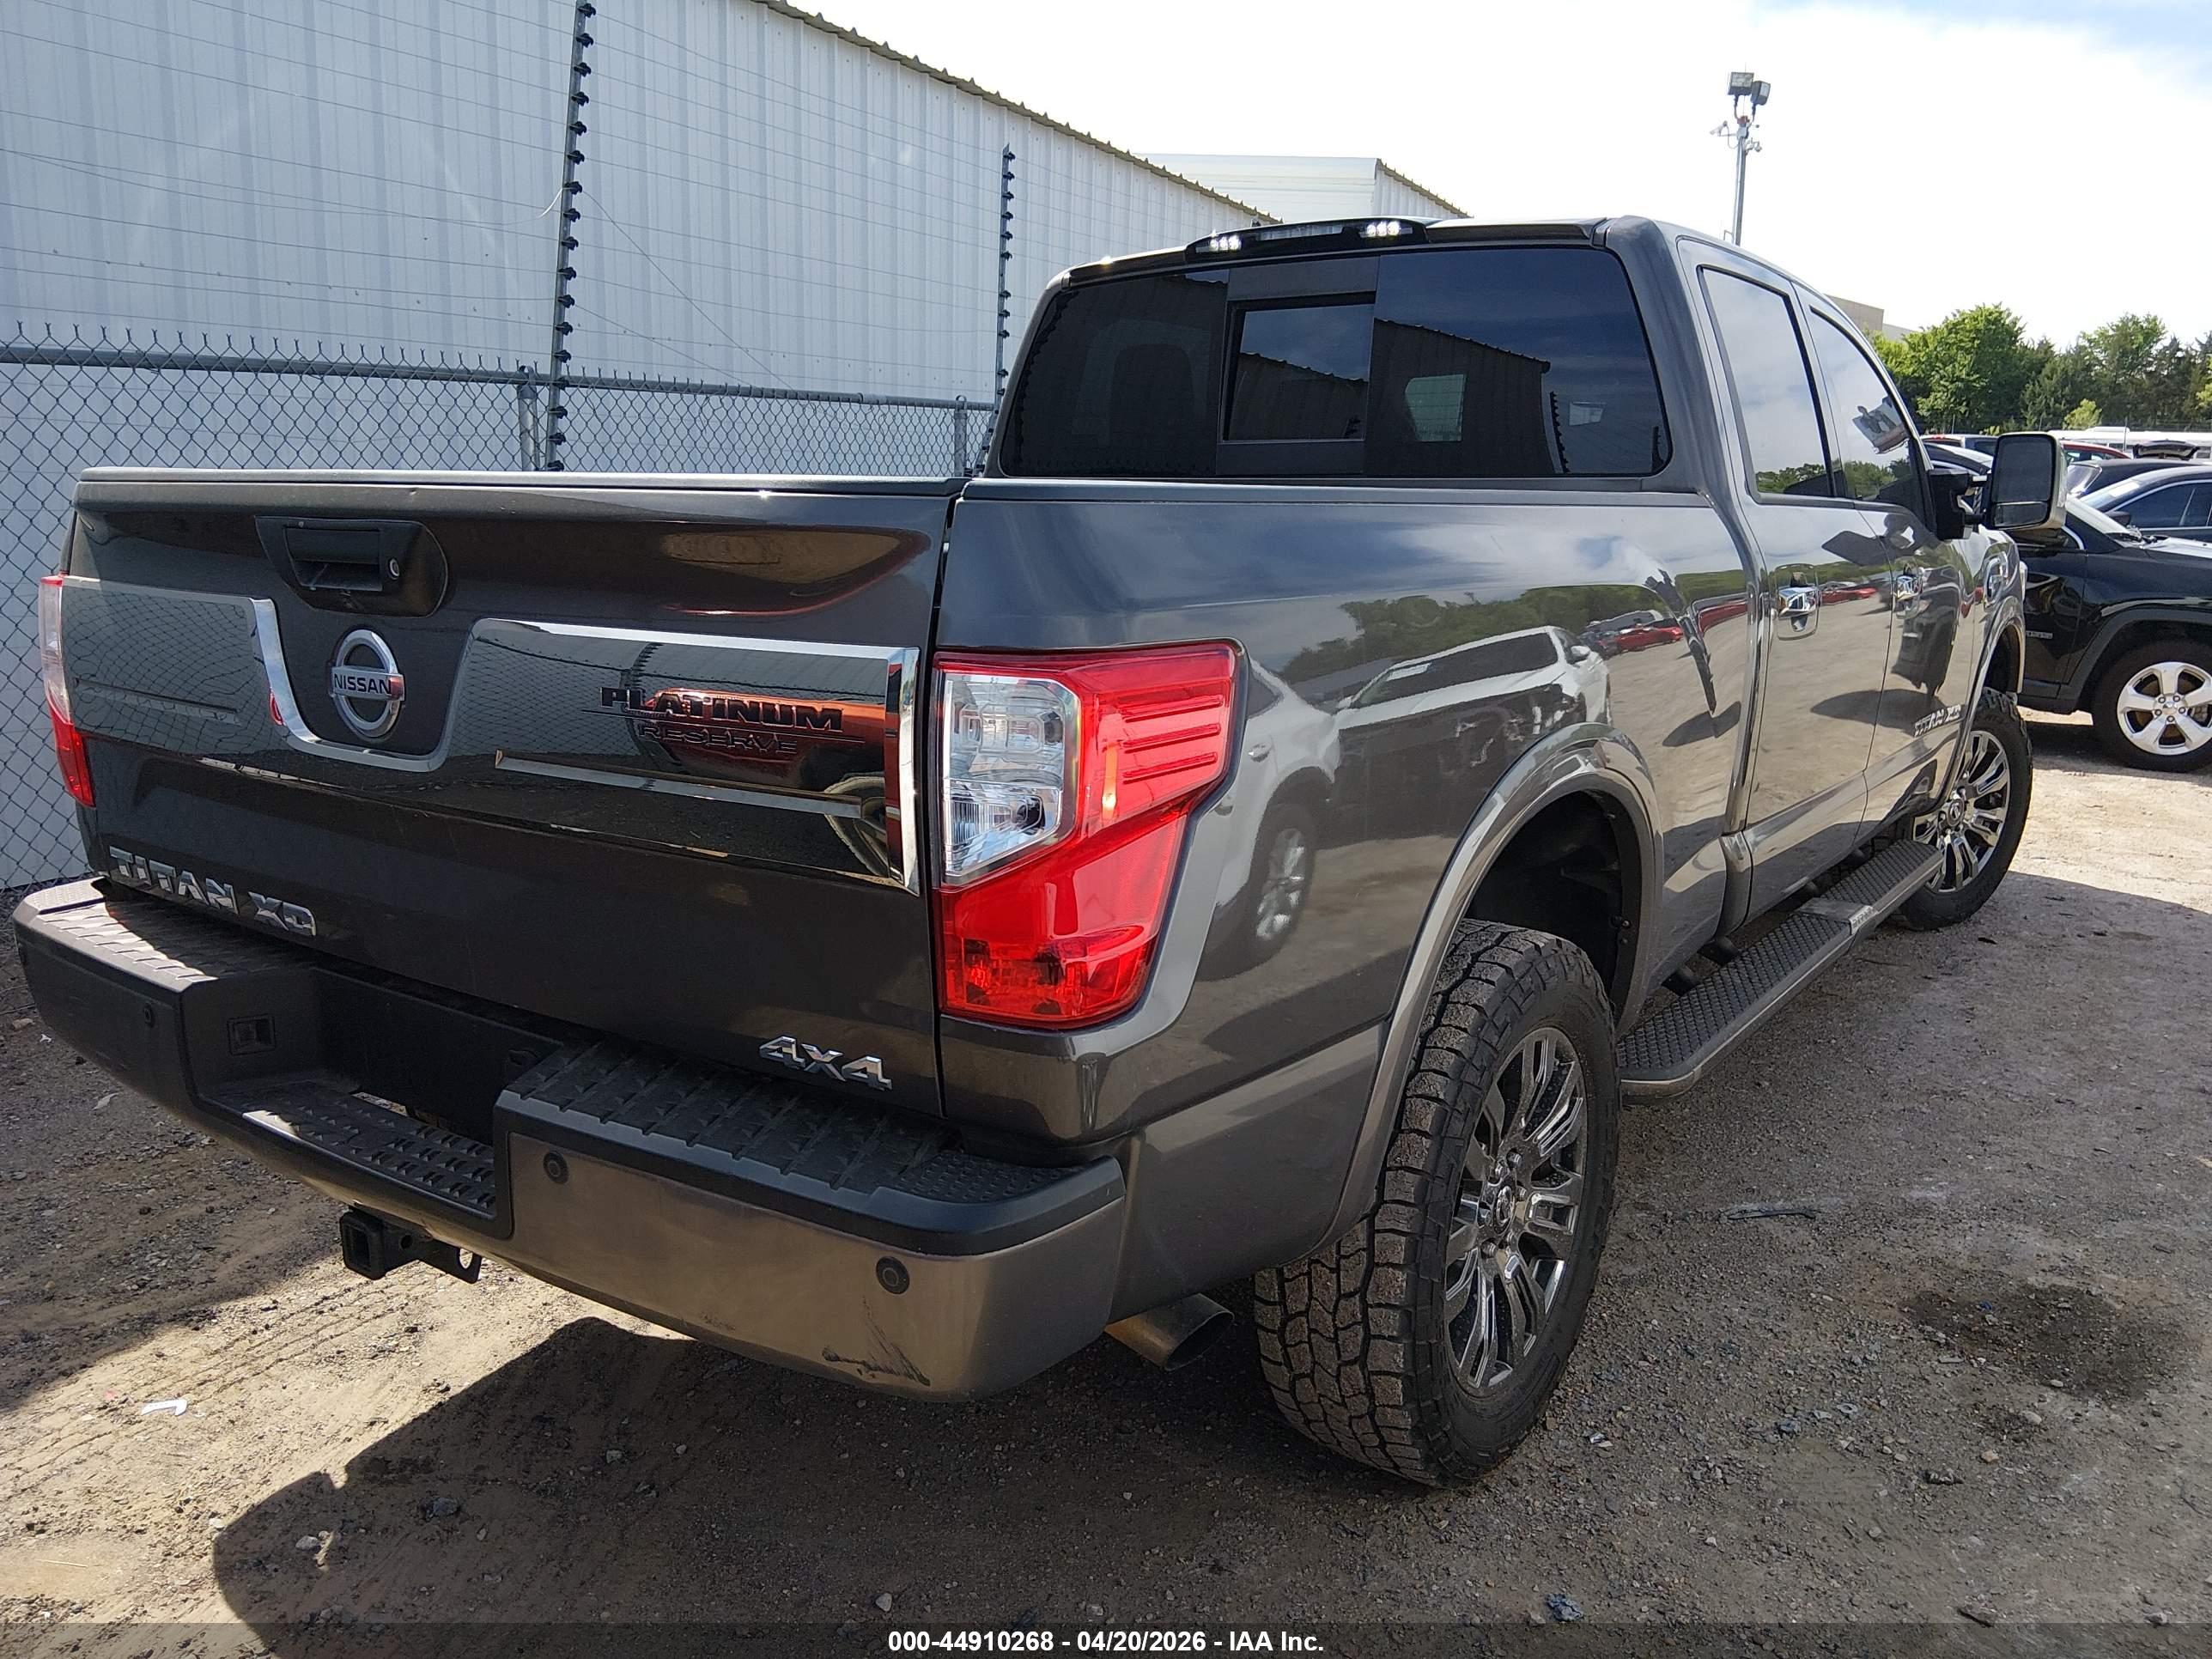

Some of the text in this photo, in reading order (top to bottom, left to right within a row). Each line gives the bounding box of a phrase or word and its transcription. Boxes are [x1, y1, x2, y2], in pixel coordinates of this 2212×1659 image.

[334, 673, 392, 695] NISSAN
[601, 687, 842, 732] PLATINUM
[638, 722, 798, 753] RESERVE
[109, 846, 317, 937] TITAN XD
